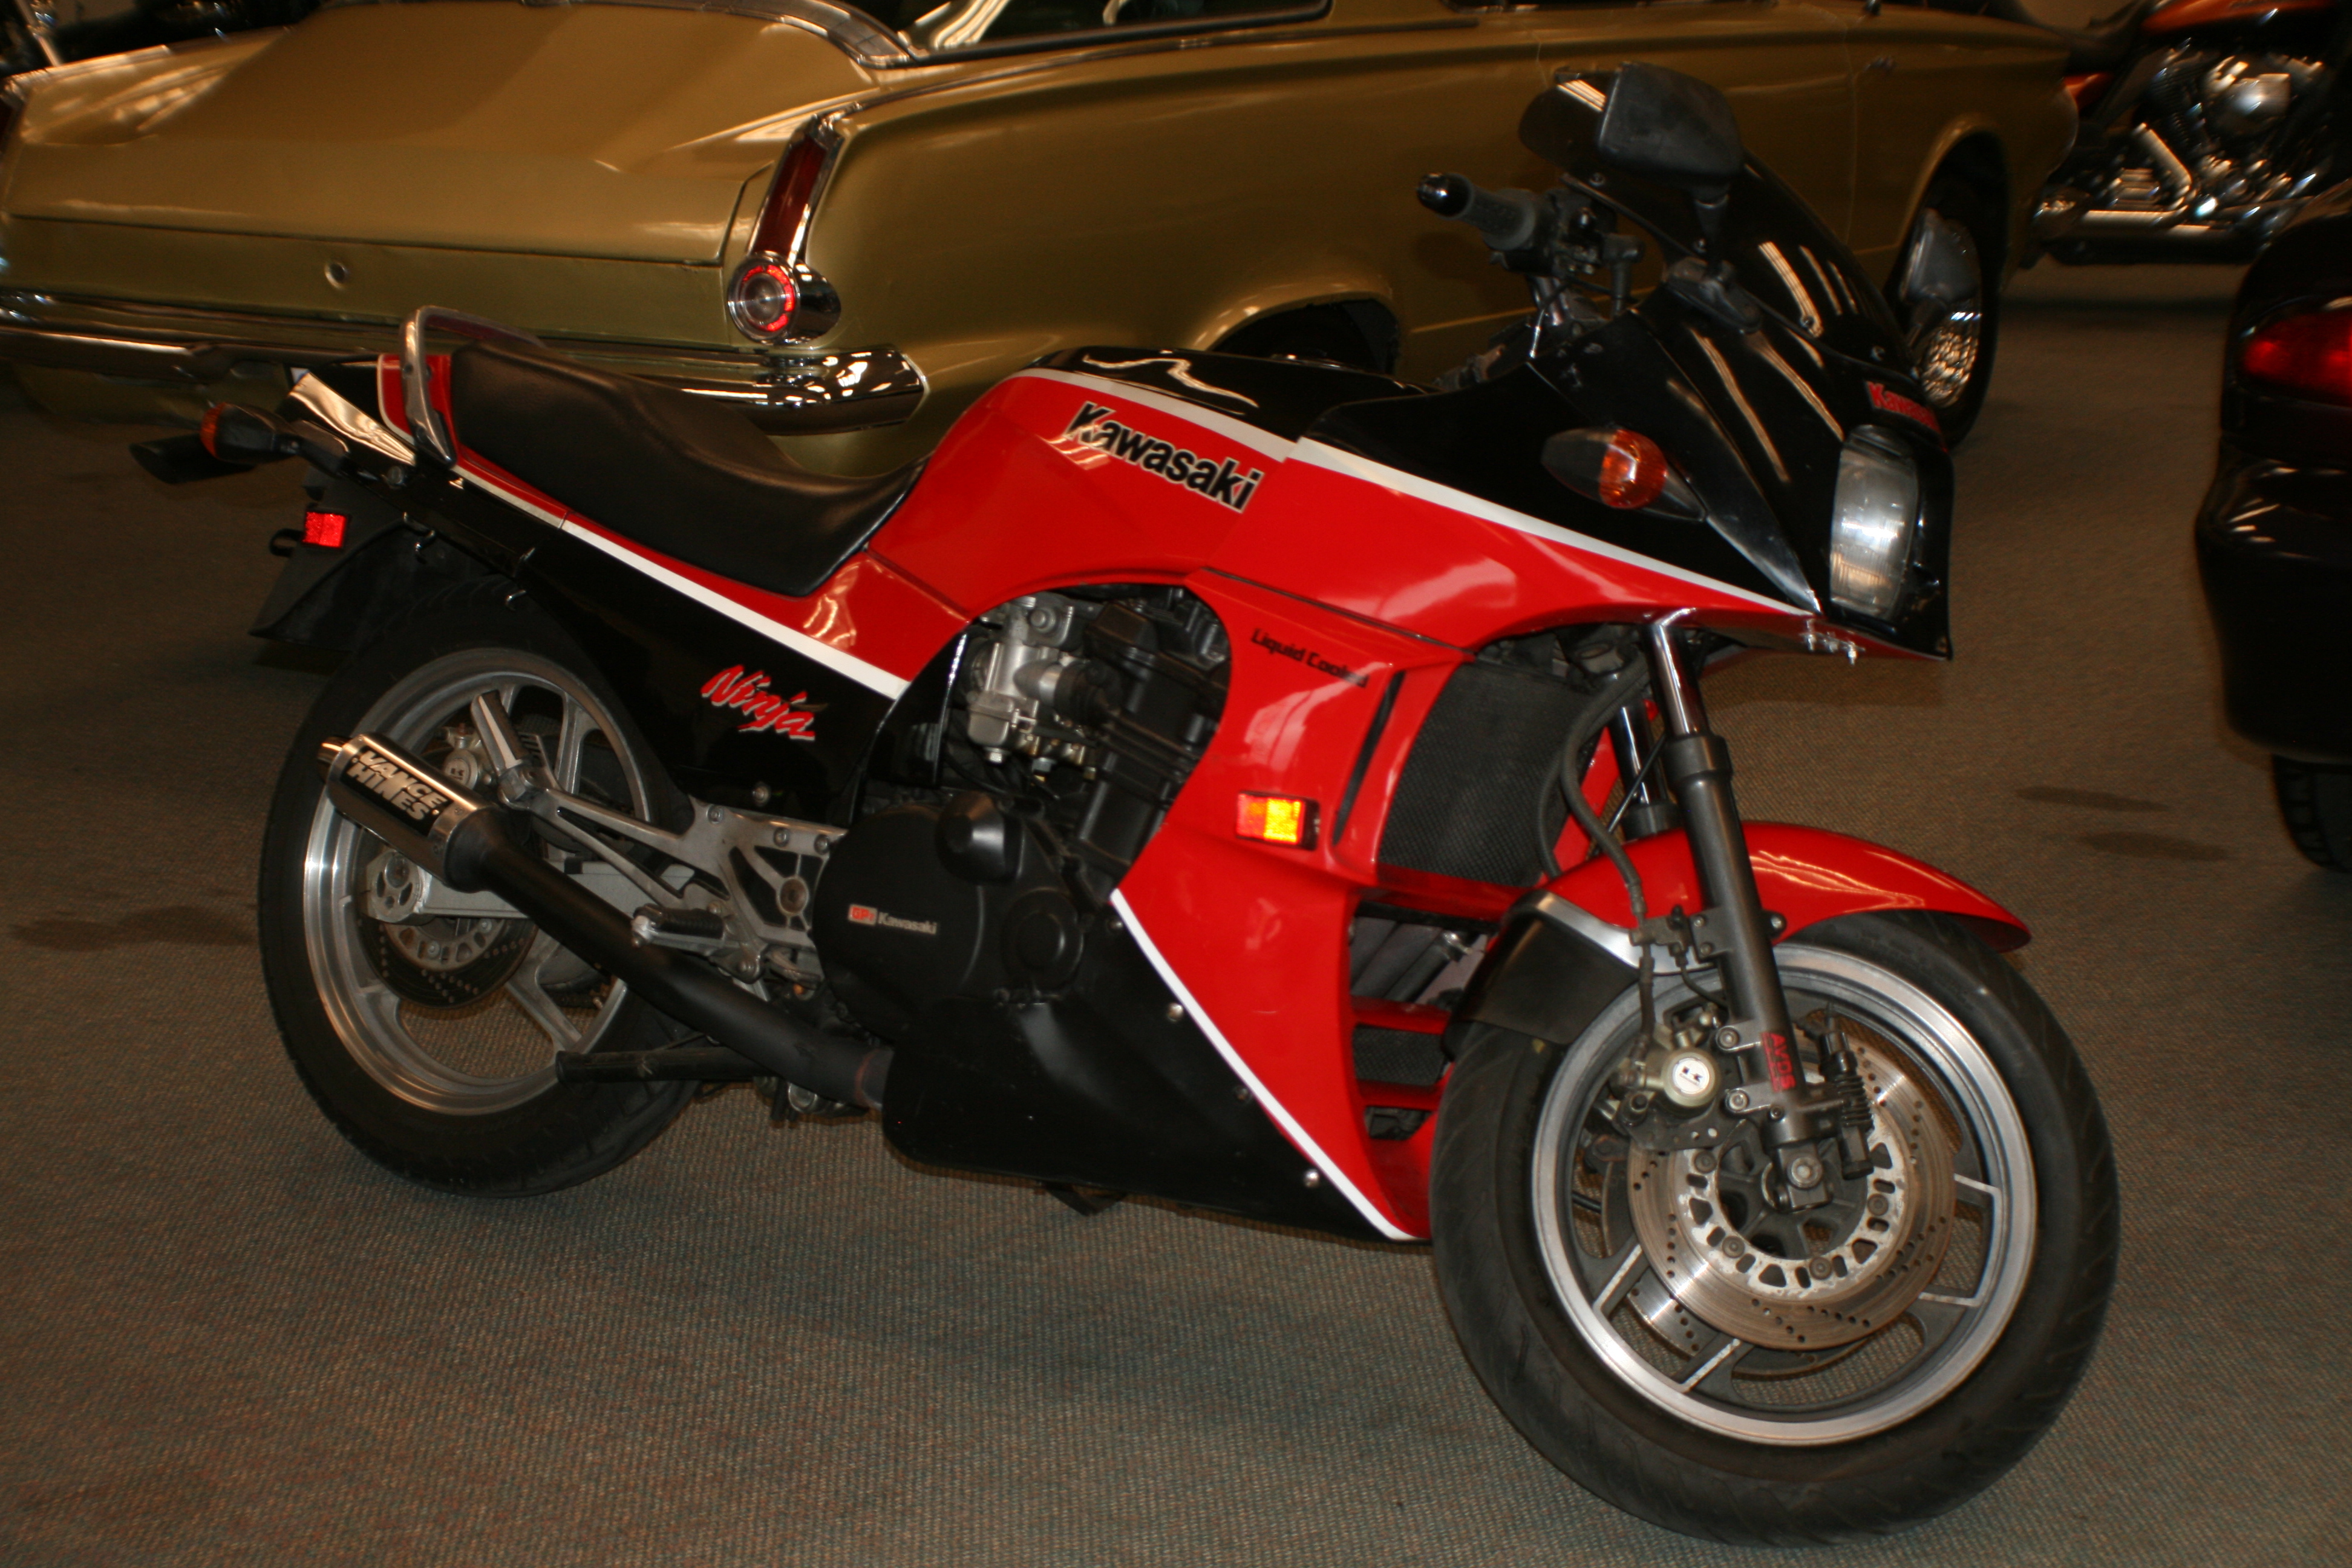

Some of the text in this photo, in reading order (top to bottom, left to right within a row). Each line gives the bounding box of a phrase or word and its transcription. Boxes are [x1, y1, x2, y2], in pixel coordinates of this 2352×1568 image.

[1063, 400, 1264, 514] Kawasaki
[1251, 627, 1305, 662] Liquid
[701, 665, 815, 740] Ninja
[346, 762, 429, 821] HINES
[359, 750, 448, 809] VANCE
